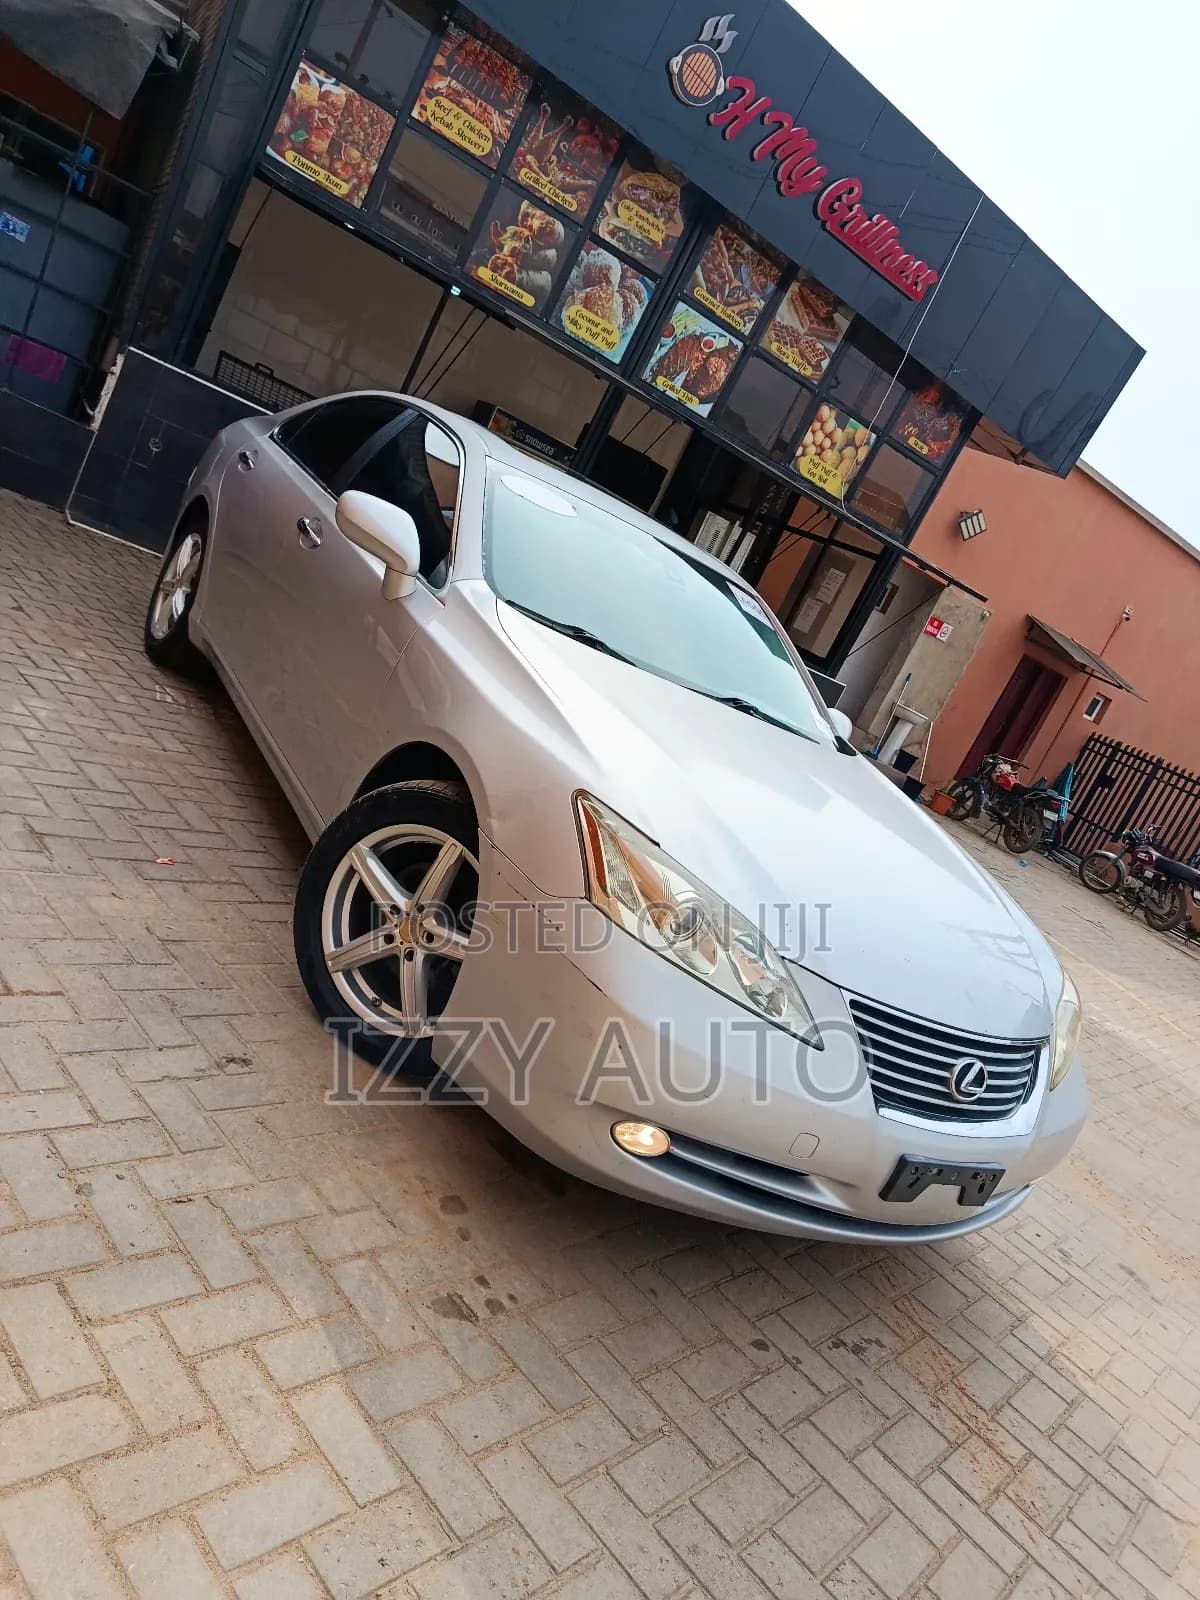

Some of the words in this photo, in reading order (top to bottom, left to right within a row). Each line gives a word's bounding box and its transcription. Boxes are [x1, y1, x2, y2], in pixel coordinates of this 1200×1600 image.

[430, 109, 454, 131] Kebab
[455, 127, 485, 153] Skewers
[434, 99, 454, 116] Beef
[453, 111, 462, 120] &
[462, 119, 491, 143] Chicken
[291, 153, 321, 177] Ponmo
[524, 171, 548, 190] Grilled
[548, 187, 573, 208] Chicken
[752, 111, 828, 198] My
[815, 177, 939, 303] Grillness
[695, 289, 721, 311] Gourmet
[575, 309, 601, 329] Coconut
[600, 326, 614, 336] and
[585, 326, 601, 341] Puff
[601, 335, 617, 351] Puff
[662, 380, 682, 395] Grilled
